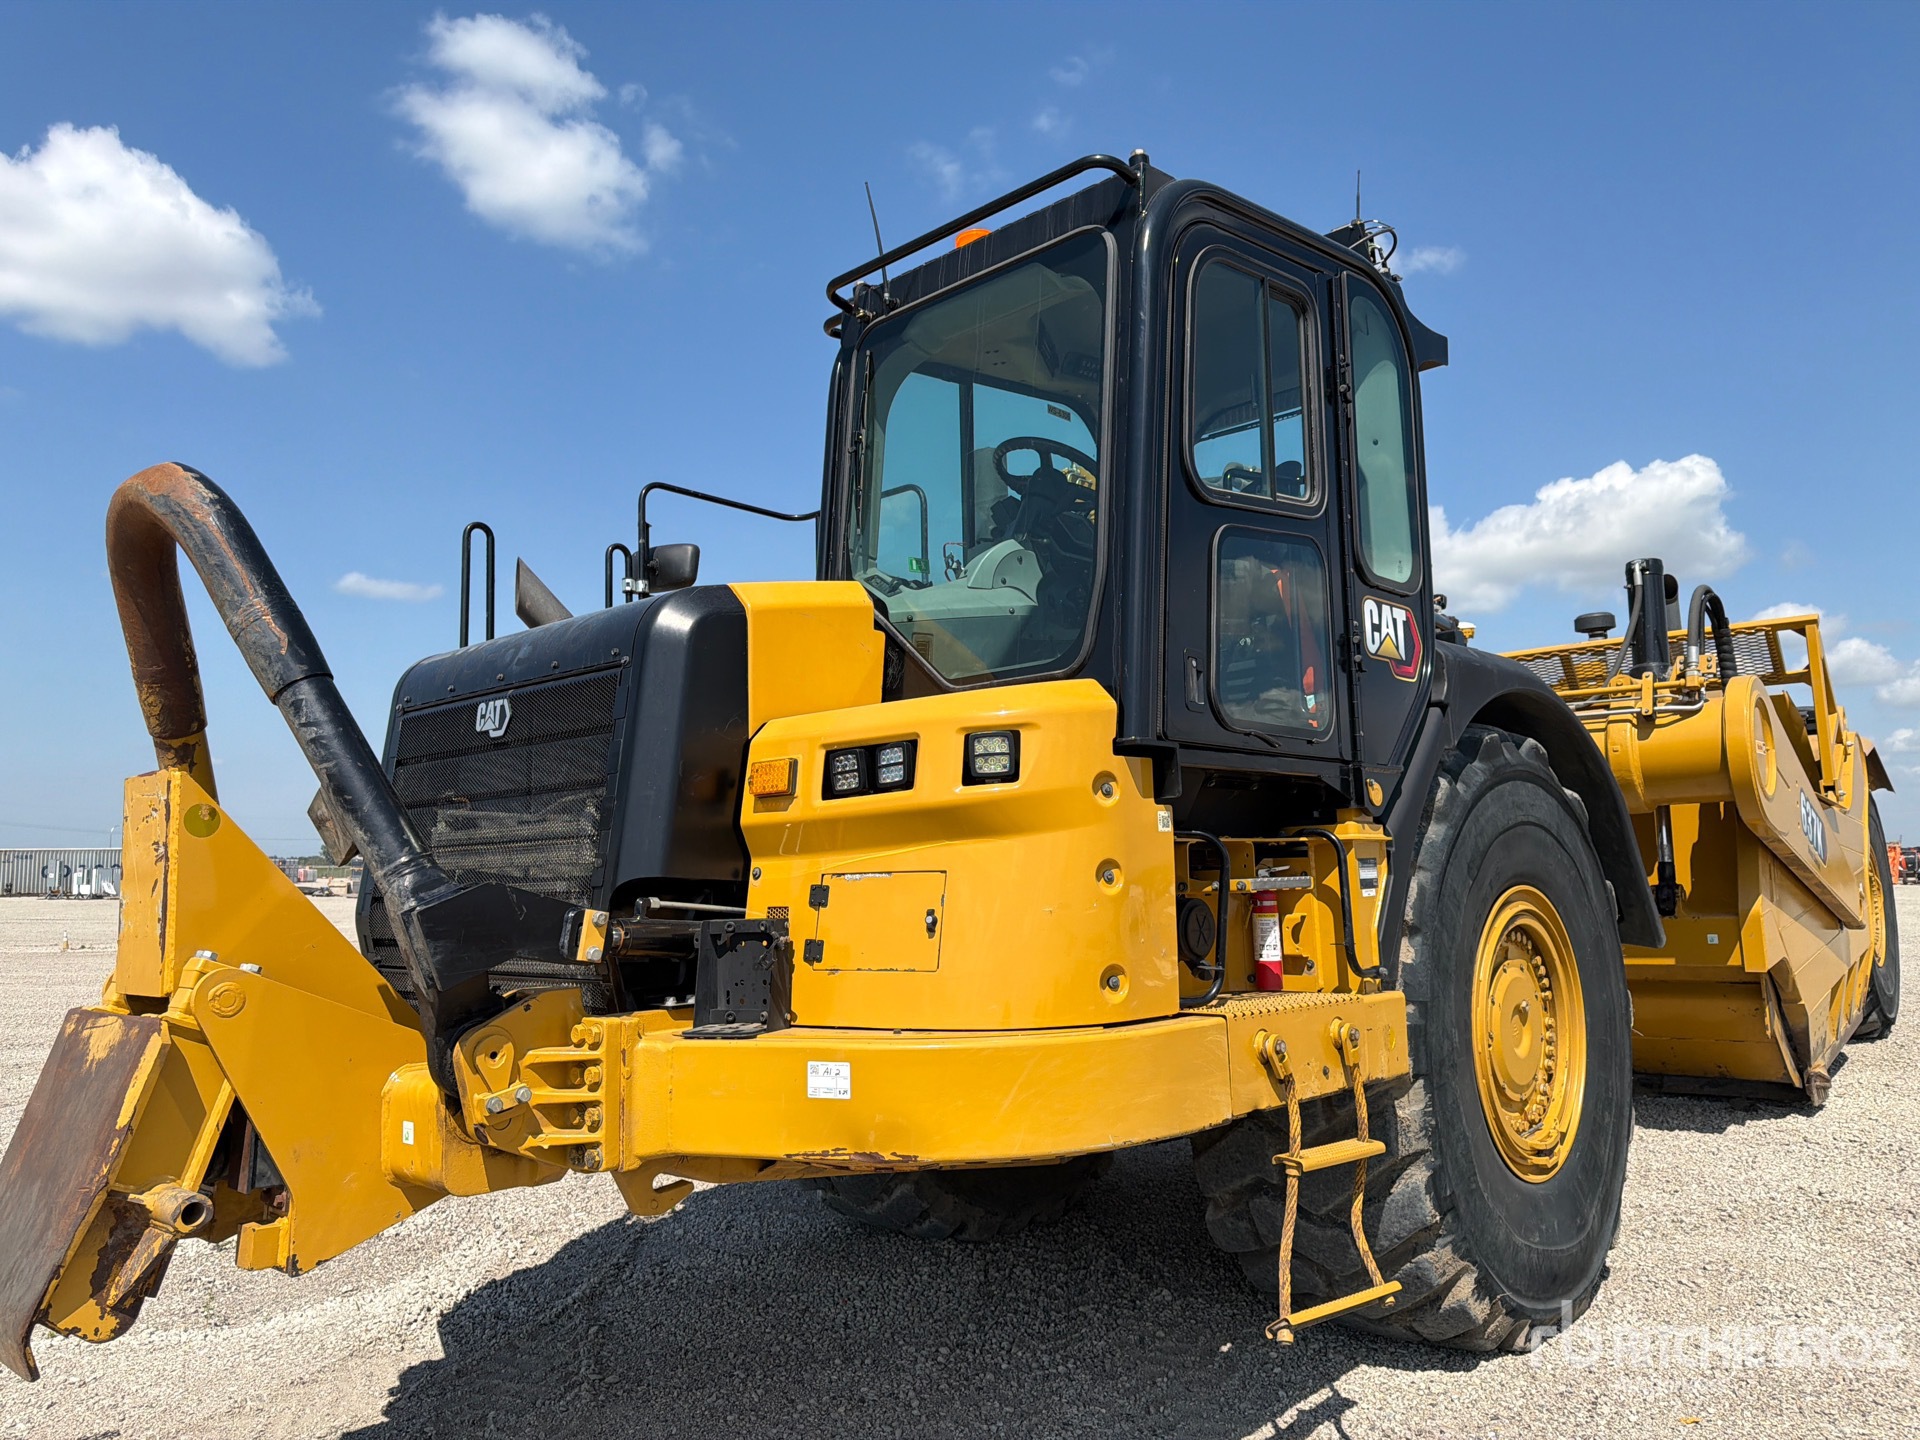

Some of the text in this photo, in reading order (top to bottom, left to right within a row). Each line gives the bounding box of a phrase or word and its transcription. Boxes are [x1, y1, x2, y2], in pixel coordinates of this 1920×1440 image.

[1363, 599, 1407, 661] CAT
[476, 699, 504, 732] CAT
[1800, 790, 1825, 861] 637K
